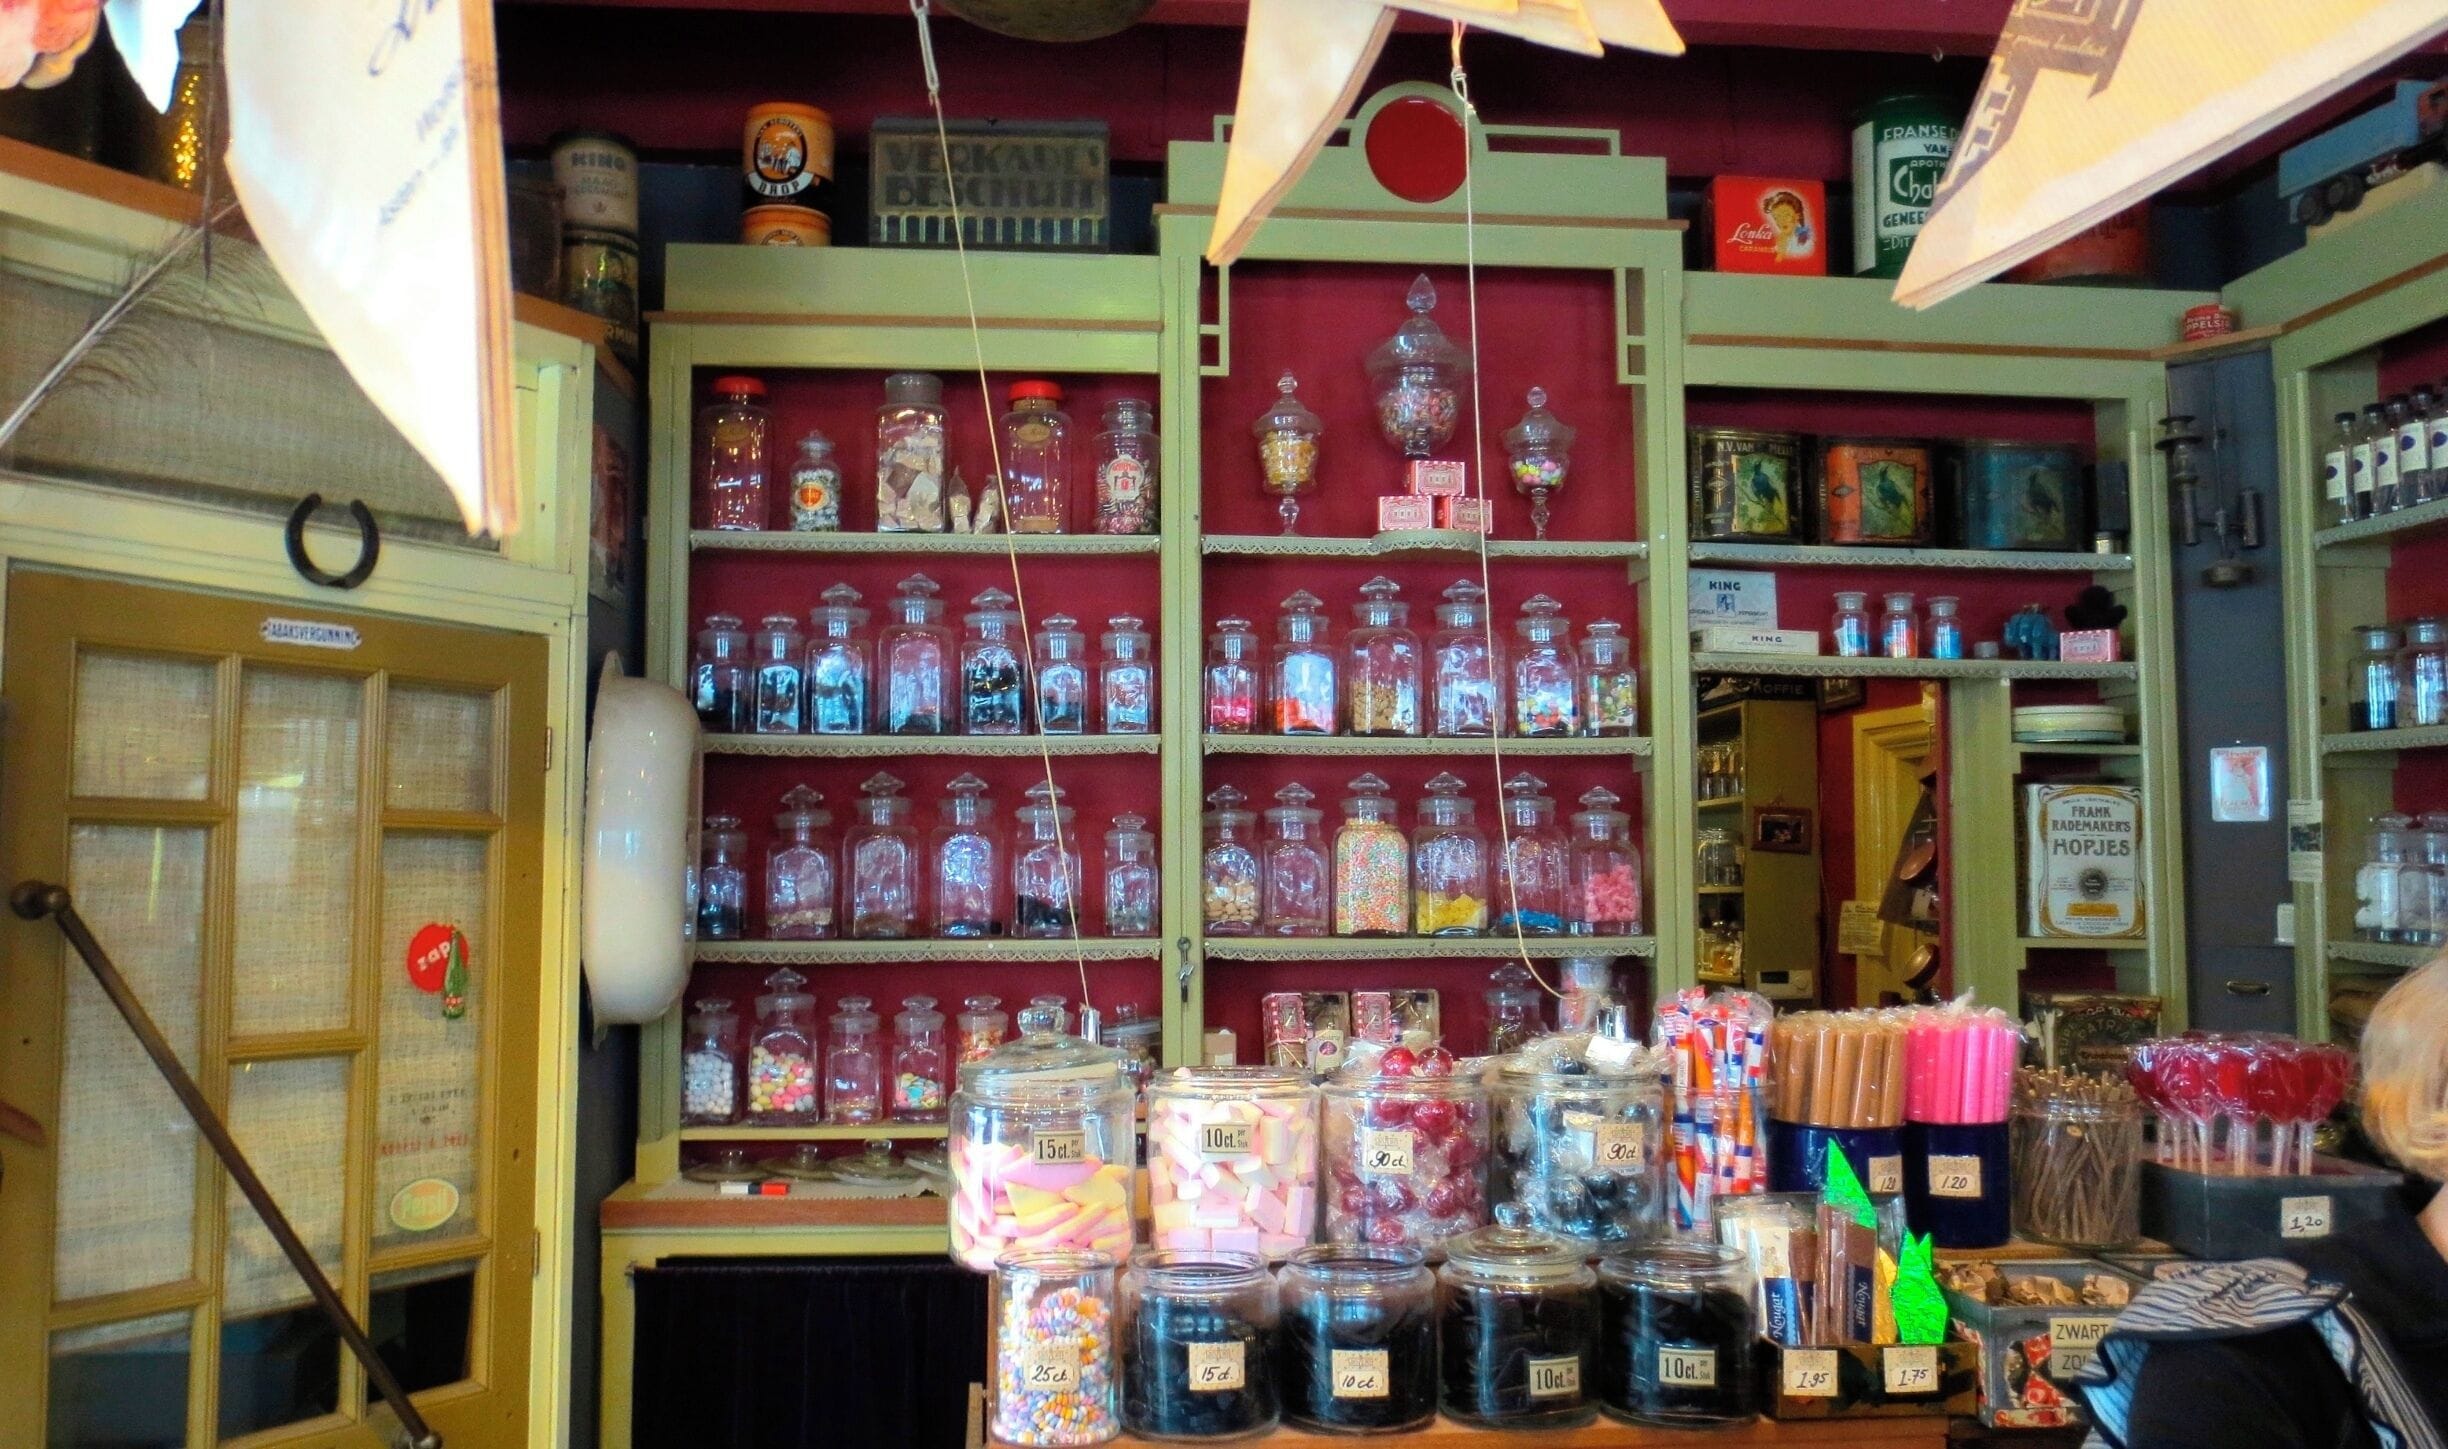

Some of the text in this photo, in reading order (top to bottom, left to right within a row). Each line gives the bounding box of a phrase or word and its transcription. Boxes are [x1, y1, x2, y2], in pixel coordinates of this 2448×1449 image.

[1884, 125, 1947, 142] FRANSE
[758, 182, 800, 196] DROP
[1709, 581, 1741, 591] KING
[1752, 635, 1782, 643] KING
[2072, 805, 2111, 818] FRANK
[2053, 839, 2130, 857] HOPJES
[1941, 1176, 1968, 1190] 1.20
[2056, 1324, 2109, 1340] ZWART
